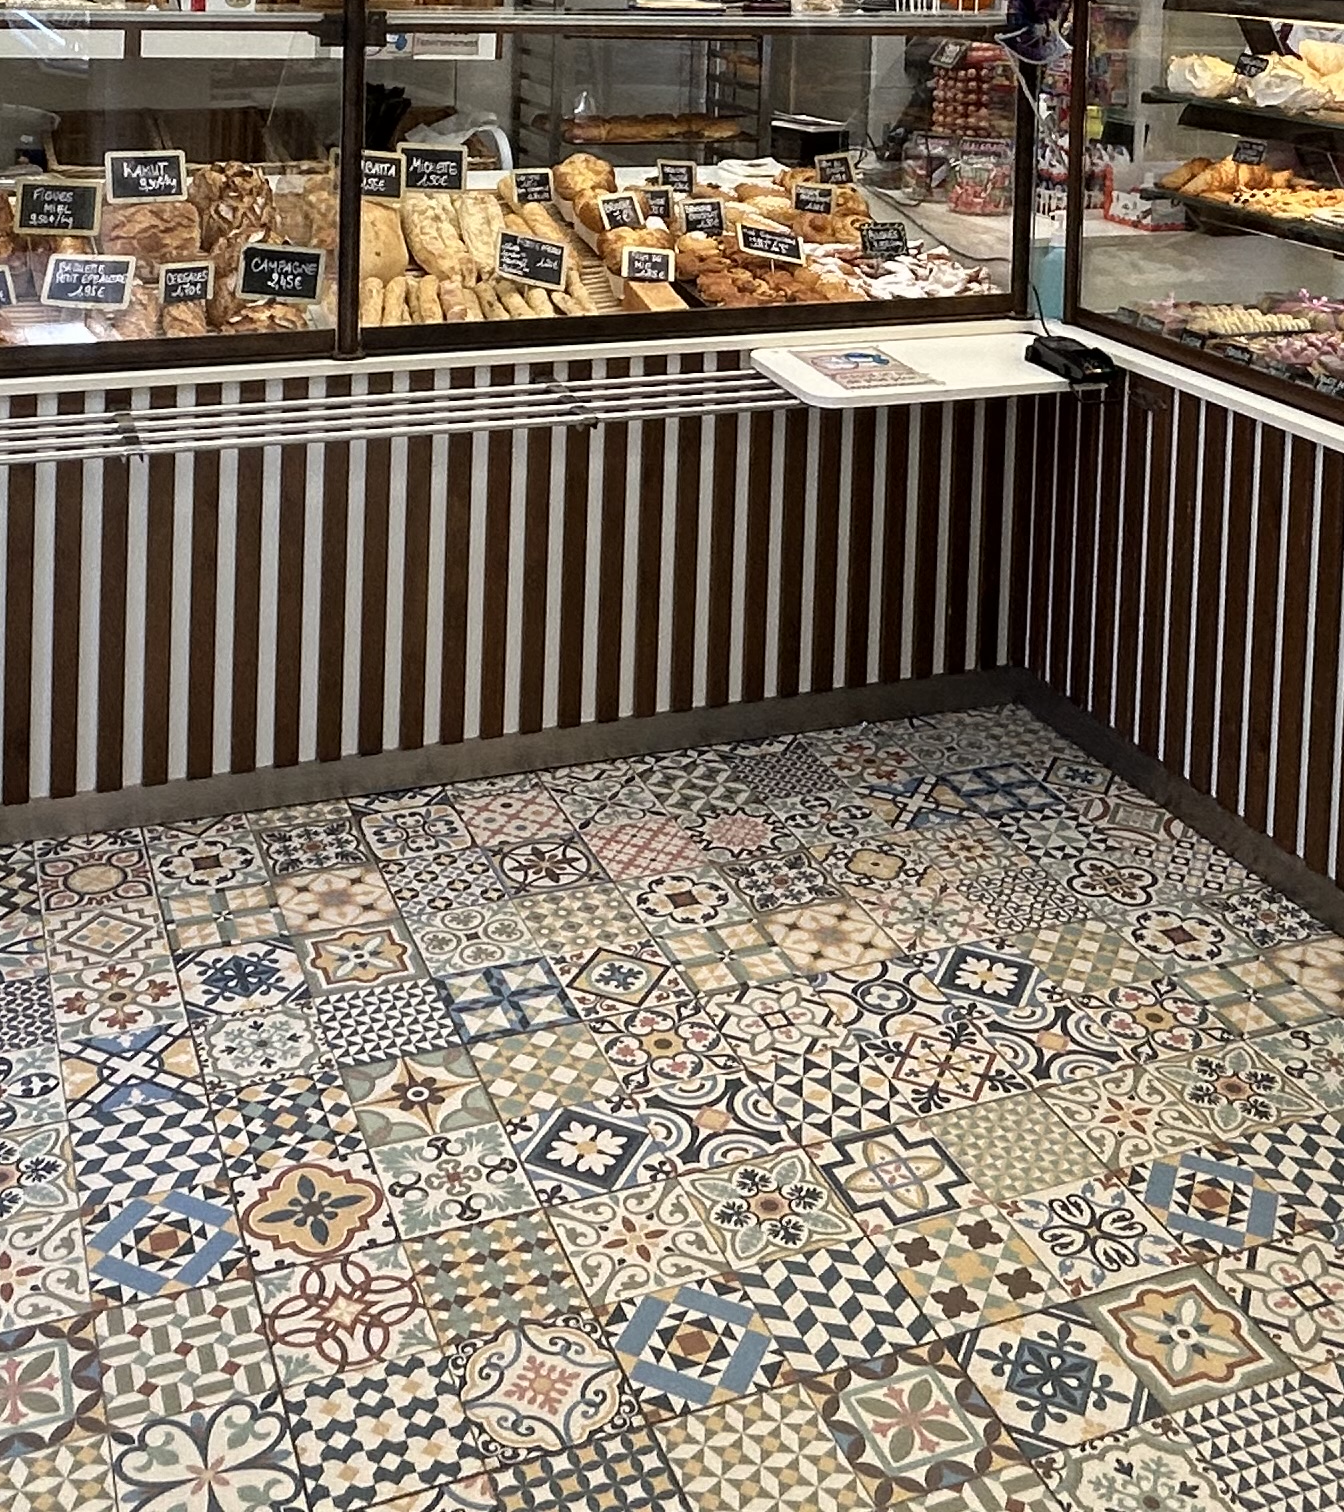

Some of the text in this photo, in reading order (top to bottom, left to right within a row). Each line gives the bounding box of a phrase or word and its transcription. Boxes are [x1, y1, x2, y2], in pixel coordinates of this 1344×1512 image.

[123, 161, 169, 178] KAMUT
[32, 189, 75, 202] FIGUES
[43, 203, 72, 215] MIEL
[251, 257, 318, 276] CAMPAGNE
